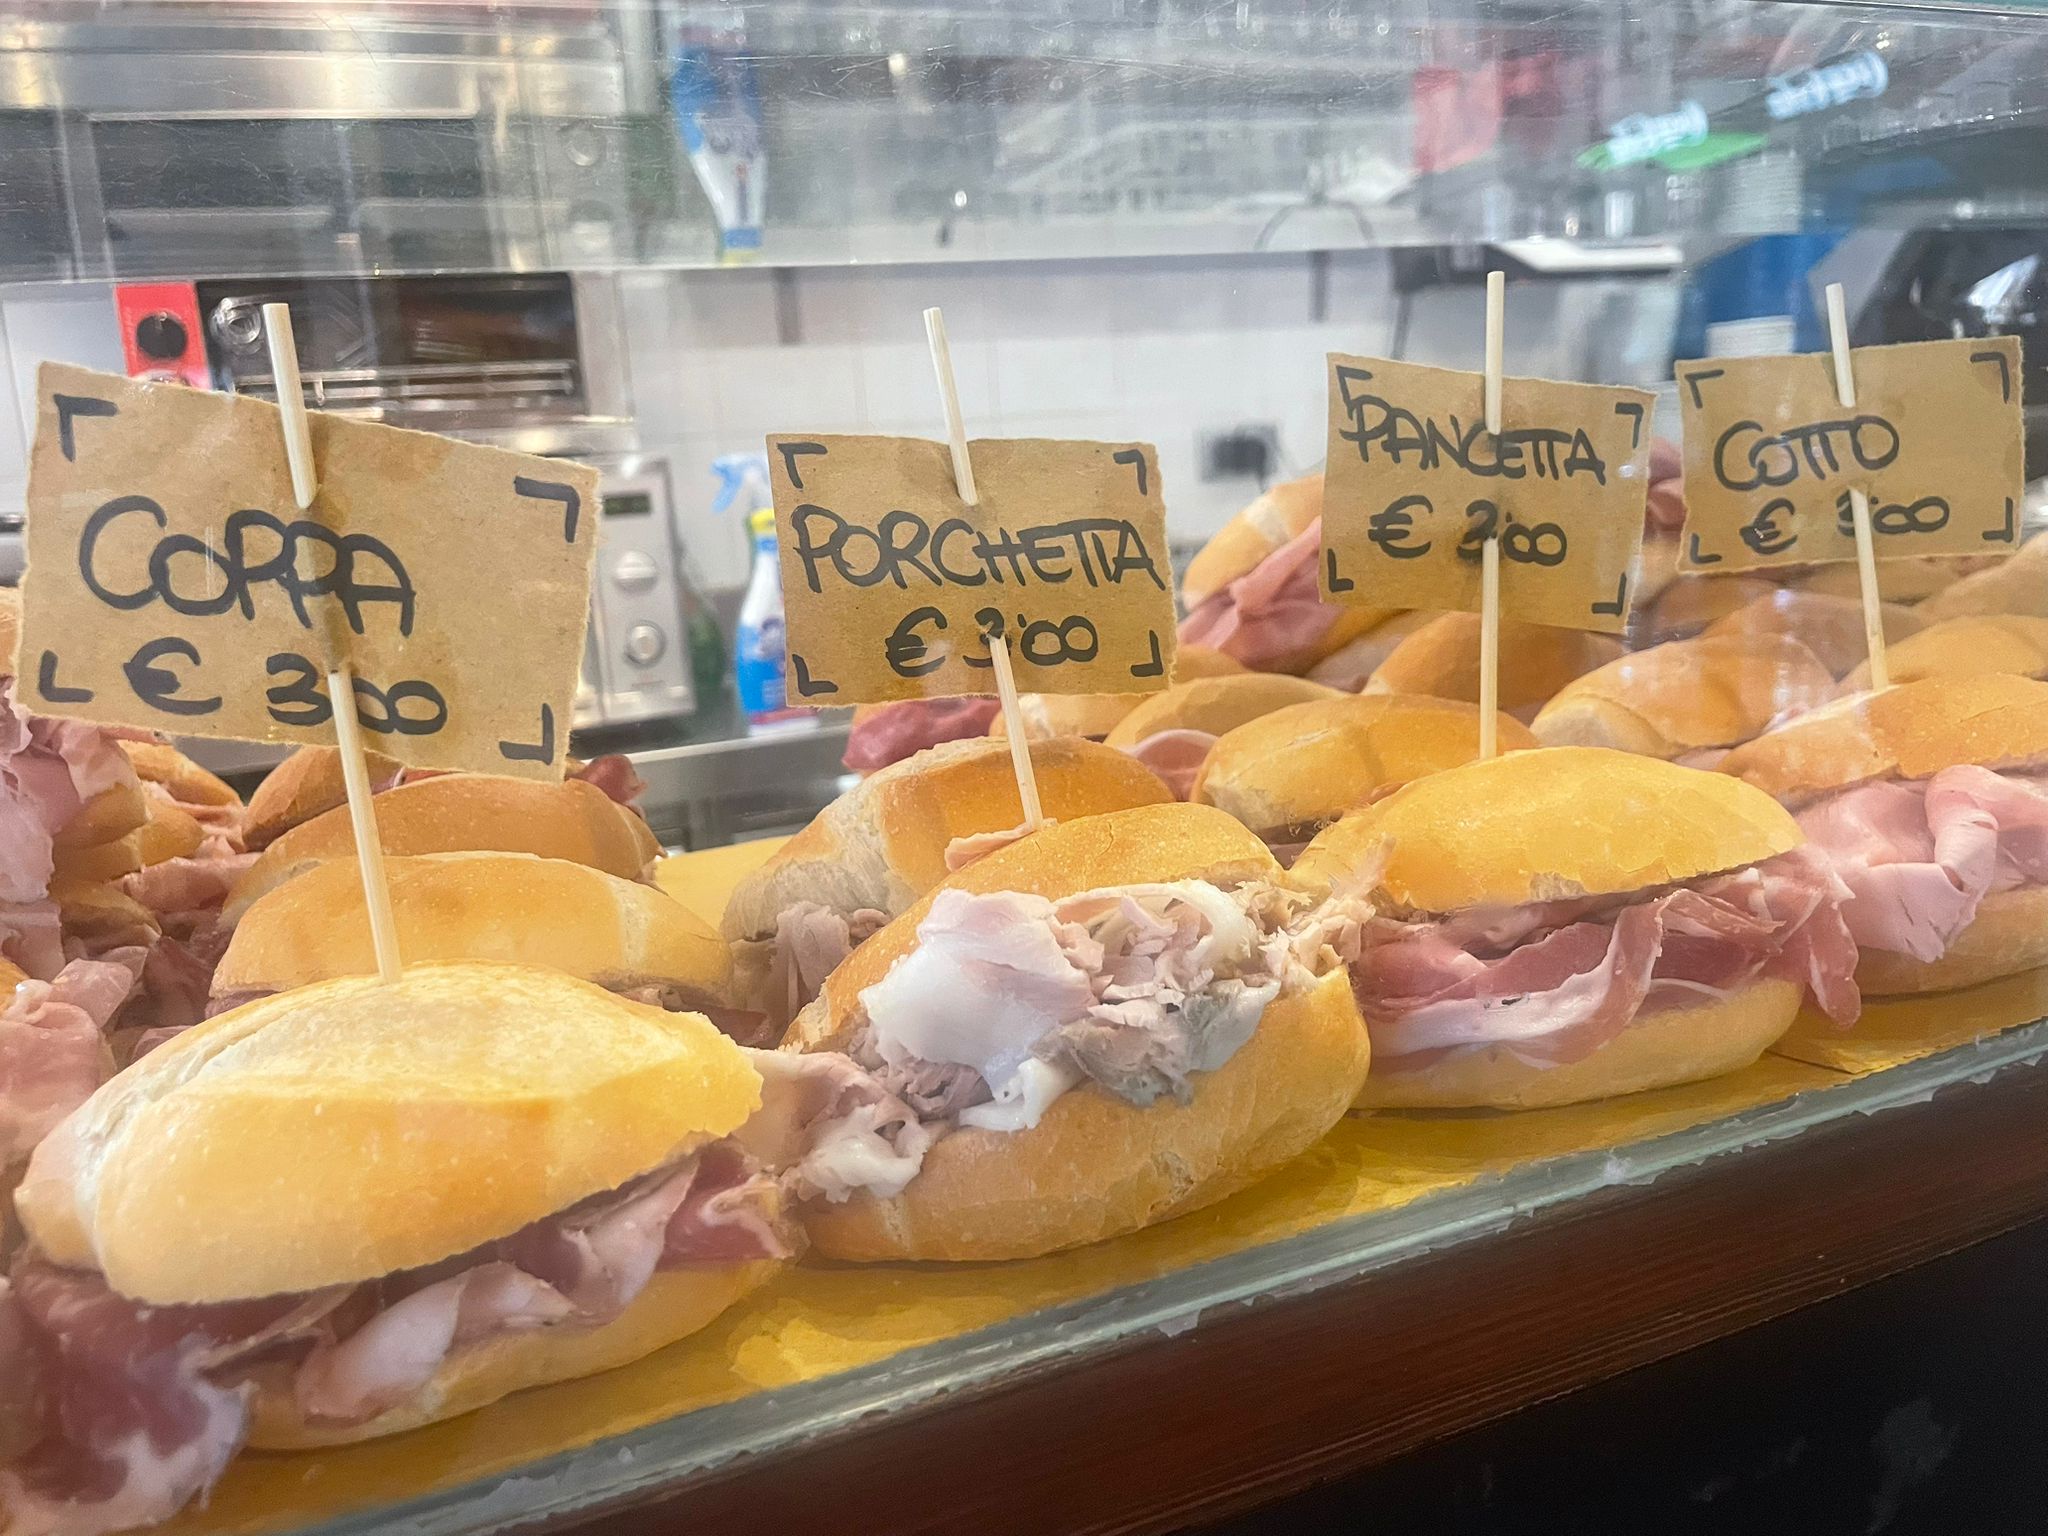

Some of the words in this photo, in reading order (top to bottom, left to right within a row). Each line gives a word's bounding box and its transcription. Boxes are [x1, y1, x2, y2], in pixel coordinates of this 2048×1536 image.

[1338, 394, 1607, 486] PANCETTA
[1713, 414, 1900, 492] COTTO
[78, 494, 417, 637] COPPA
[790, 503, 1167, 594] PORCHETTA
[1367, 494, 1434, 560] €
[1738, 497, 1799, 556] €
[122, 636, 223, 716] €
[885, 605, 948, 679] €
